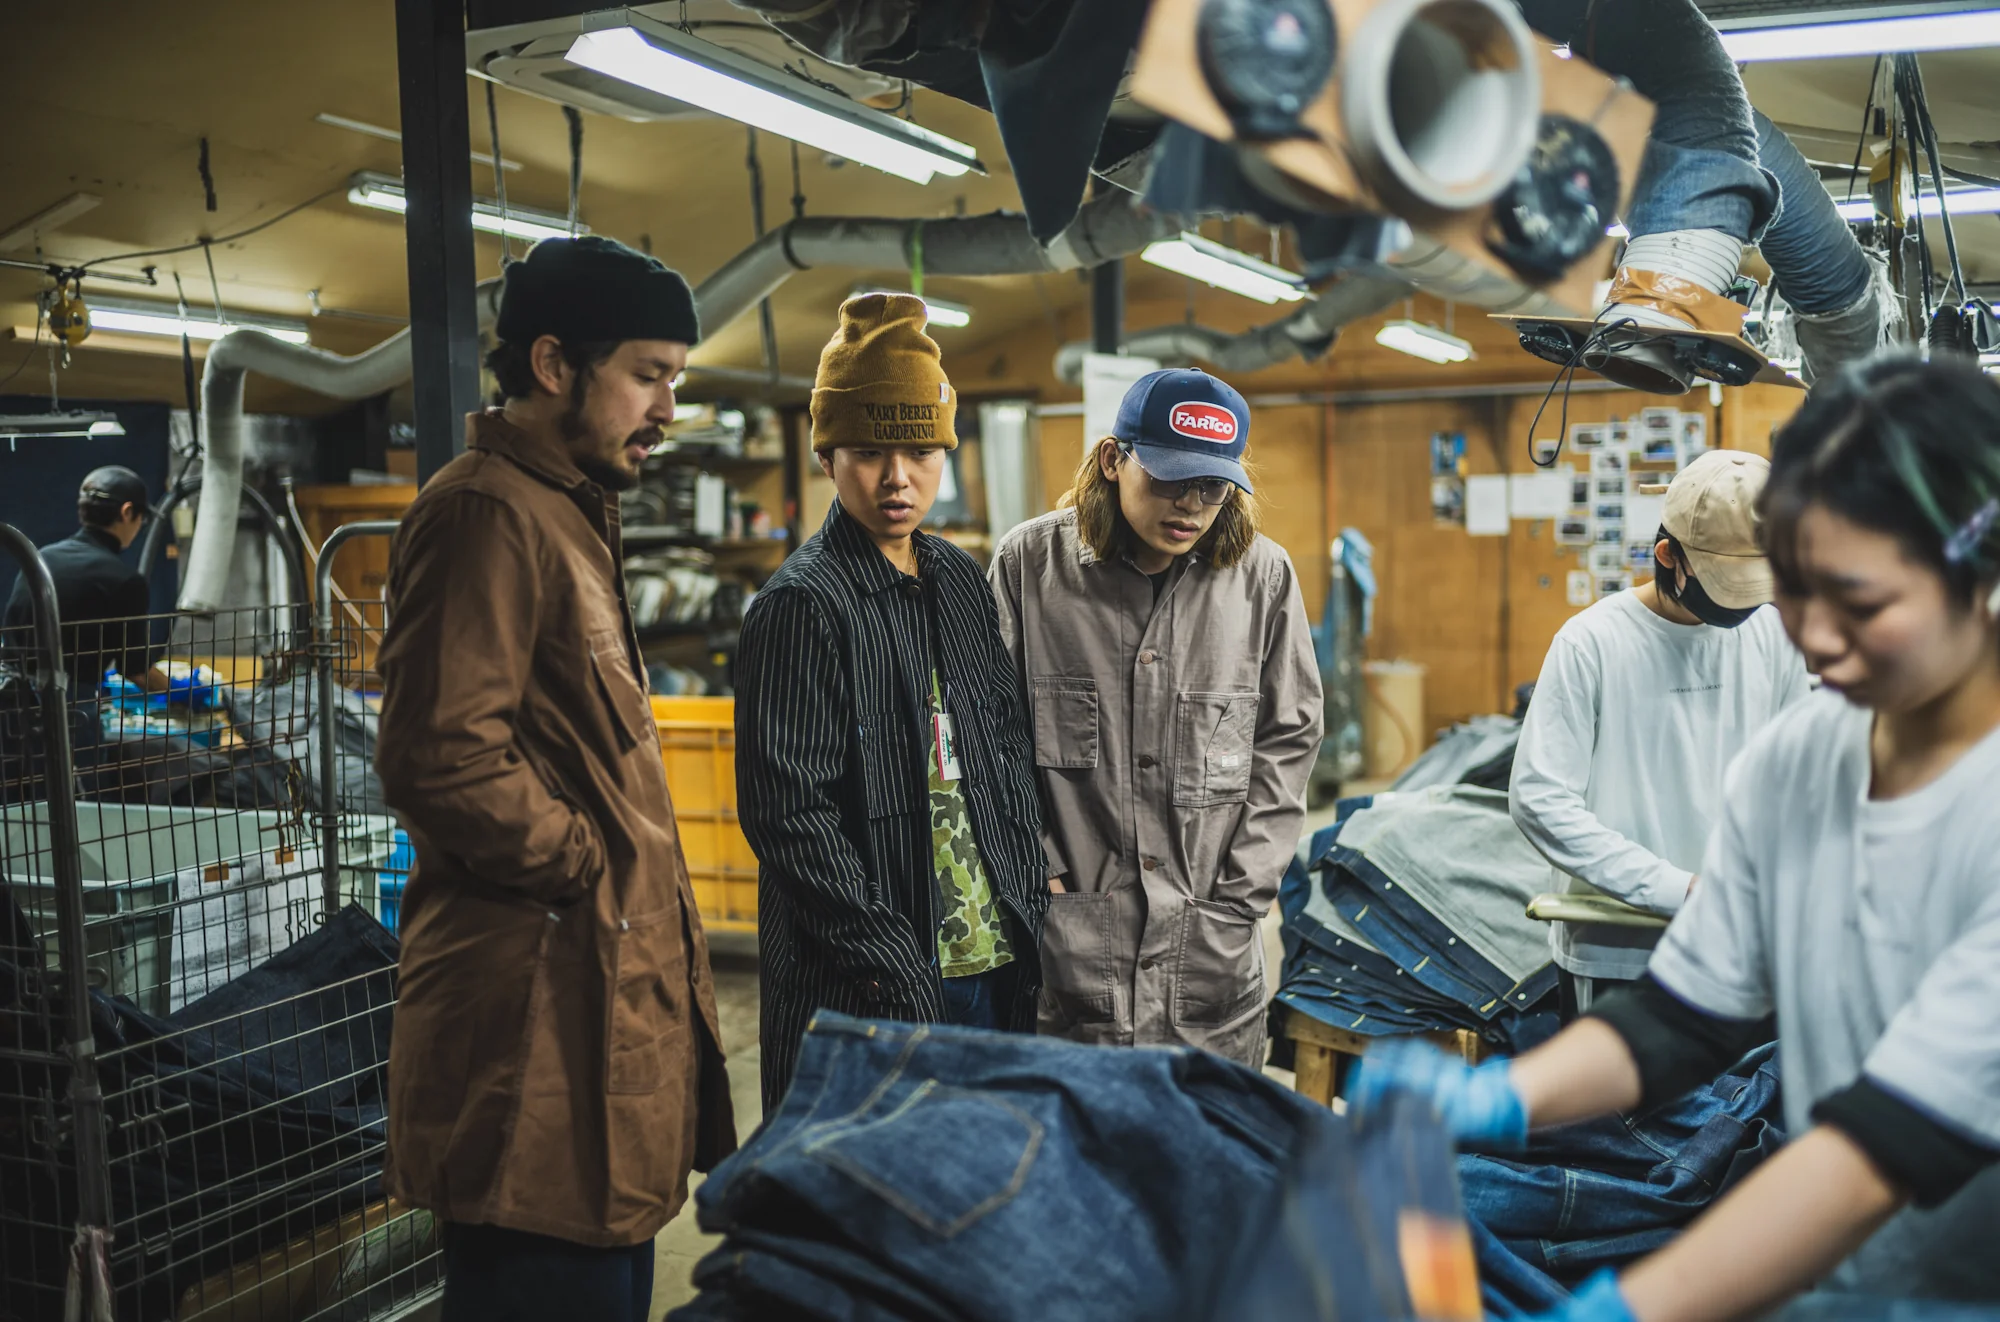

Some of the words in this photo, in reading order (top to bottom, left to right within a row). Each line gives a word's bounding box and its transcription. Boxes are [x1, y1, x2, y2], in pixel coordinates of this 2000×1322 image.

[865, 403, 897, 422] MARY
[898, 402, 940, 421] BERRY'S
[873, 422, 935, 440] GARDENING
[1175, 411, 1234, 435] FARTCO
